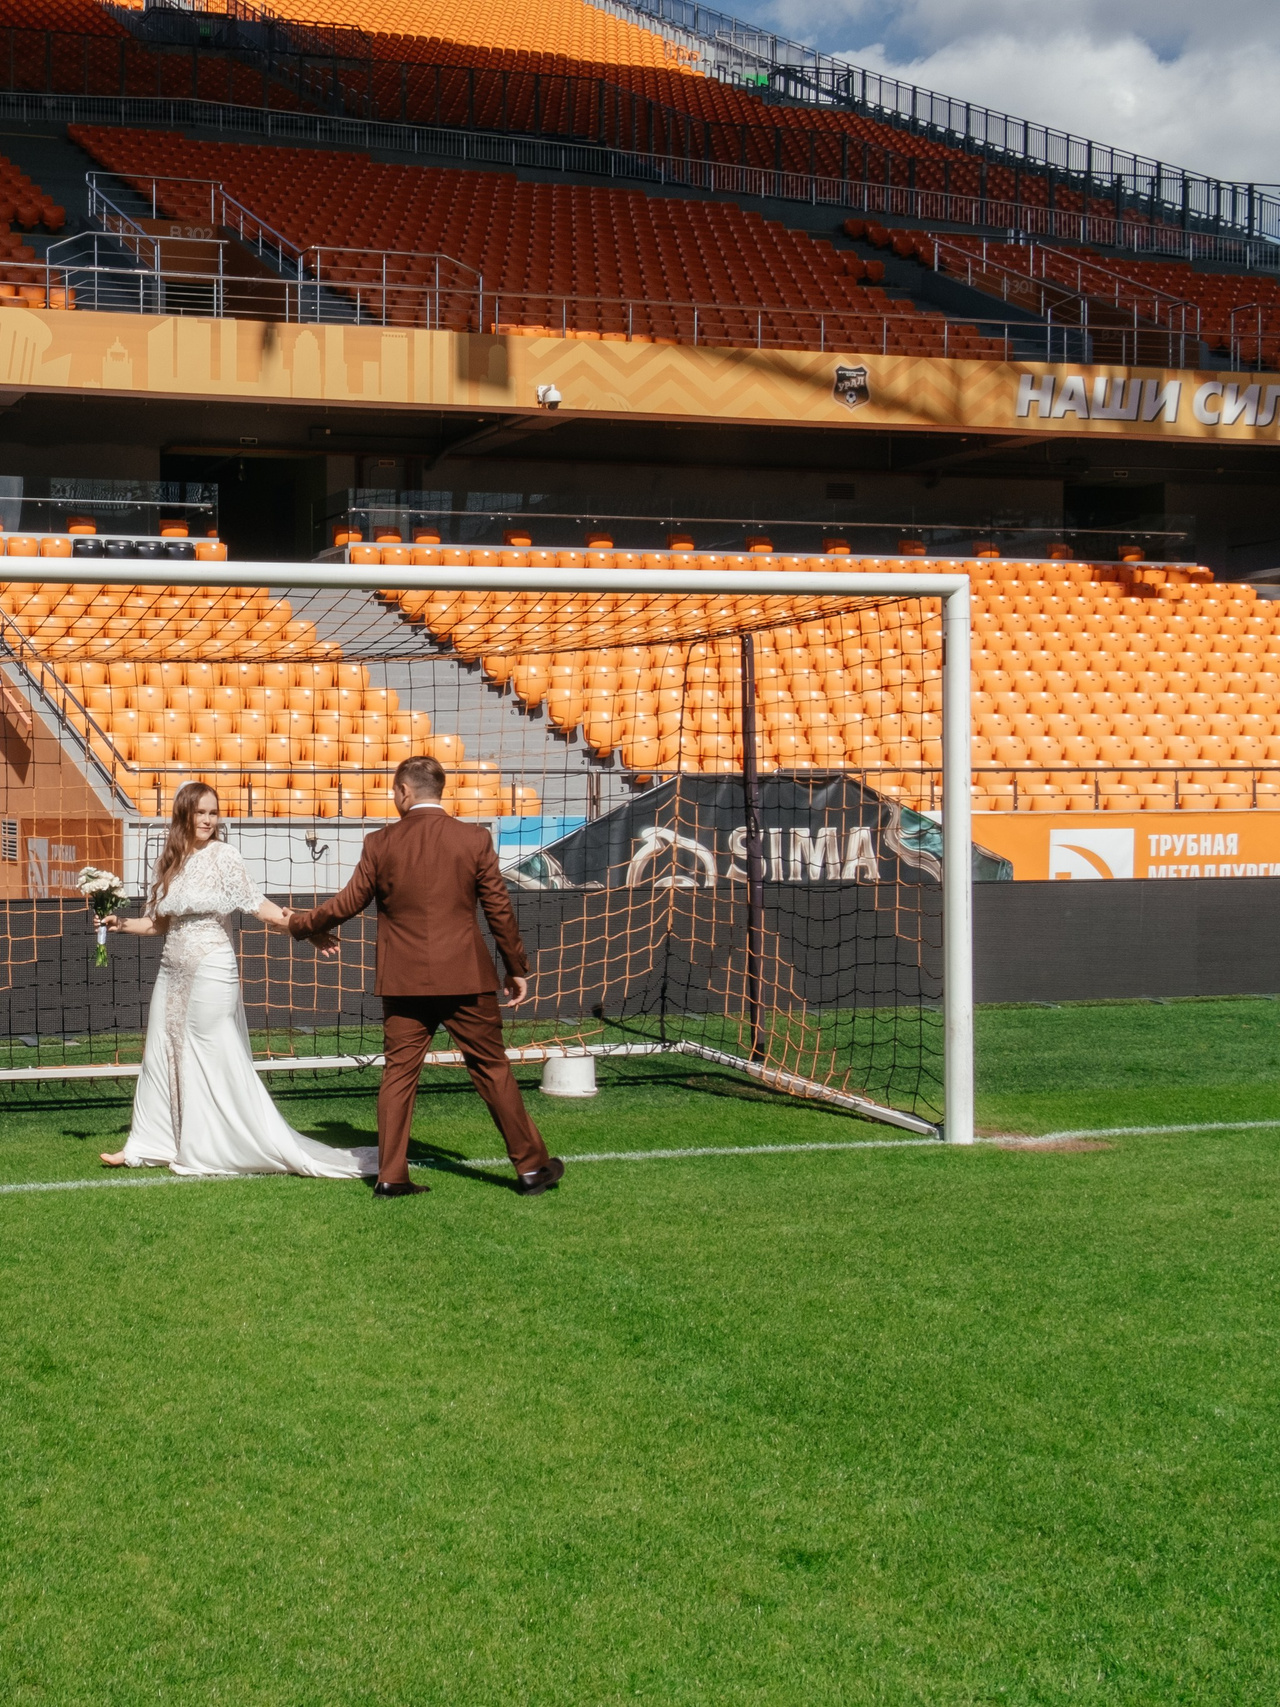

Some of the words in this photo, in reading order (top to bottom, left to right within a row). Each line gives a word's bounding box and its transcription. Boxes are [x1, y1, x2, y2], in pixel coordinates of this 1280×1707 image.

[1016, 374, 1182, 423] НАШИ
[725, 826, 881, 882] SIMA
[1148, 833, 1238, 857] ТРУБНАЯ
